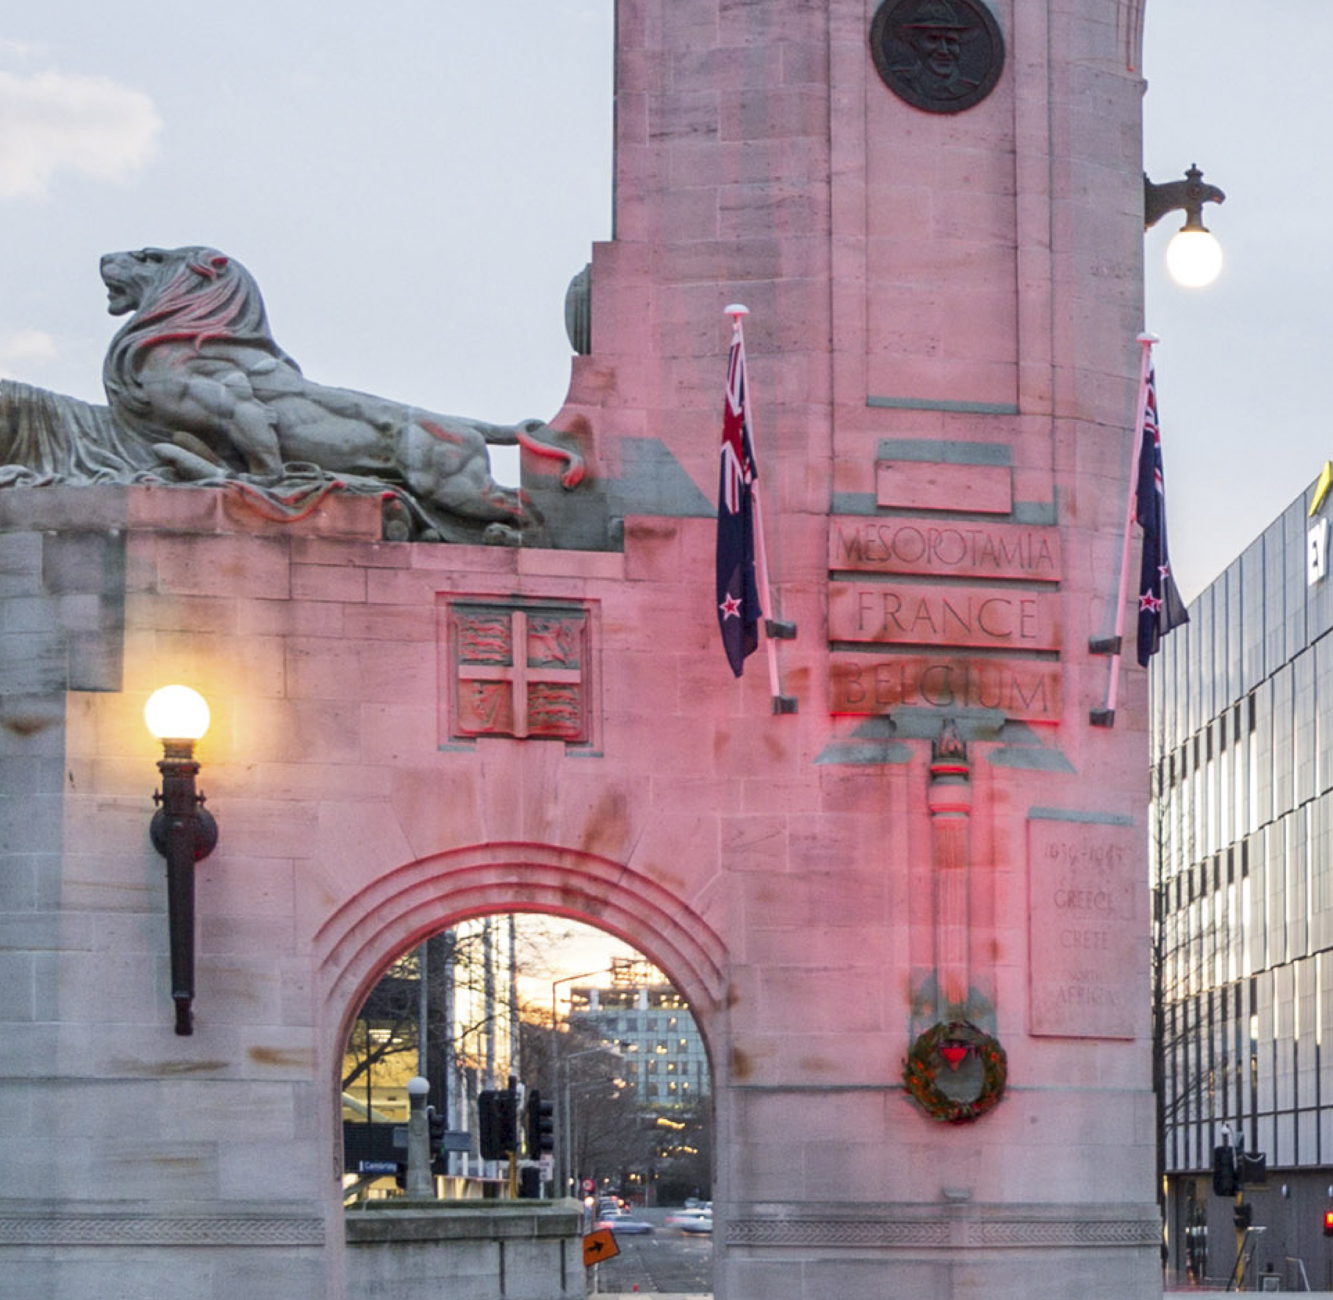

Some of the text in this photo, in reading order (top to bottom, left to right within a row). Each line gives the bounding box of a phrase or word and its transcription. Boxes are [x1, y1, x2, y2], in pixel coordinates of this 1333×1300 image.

[836, 523, 1055, 570] MESOPOTAMIA
[857, 591, 1037, 639] FRANCE
[845, 662, 1048, 712] BELGIUM
